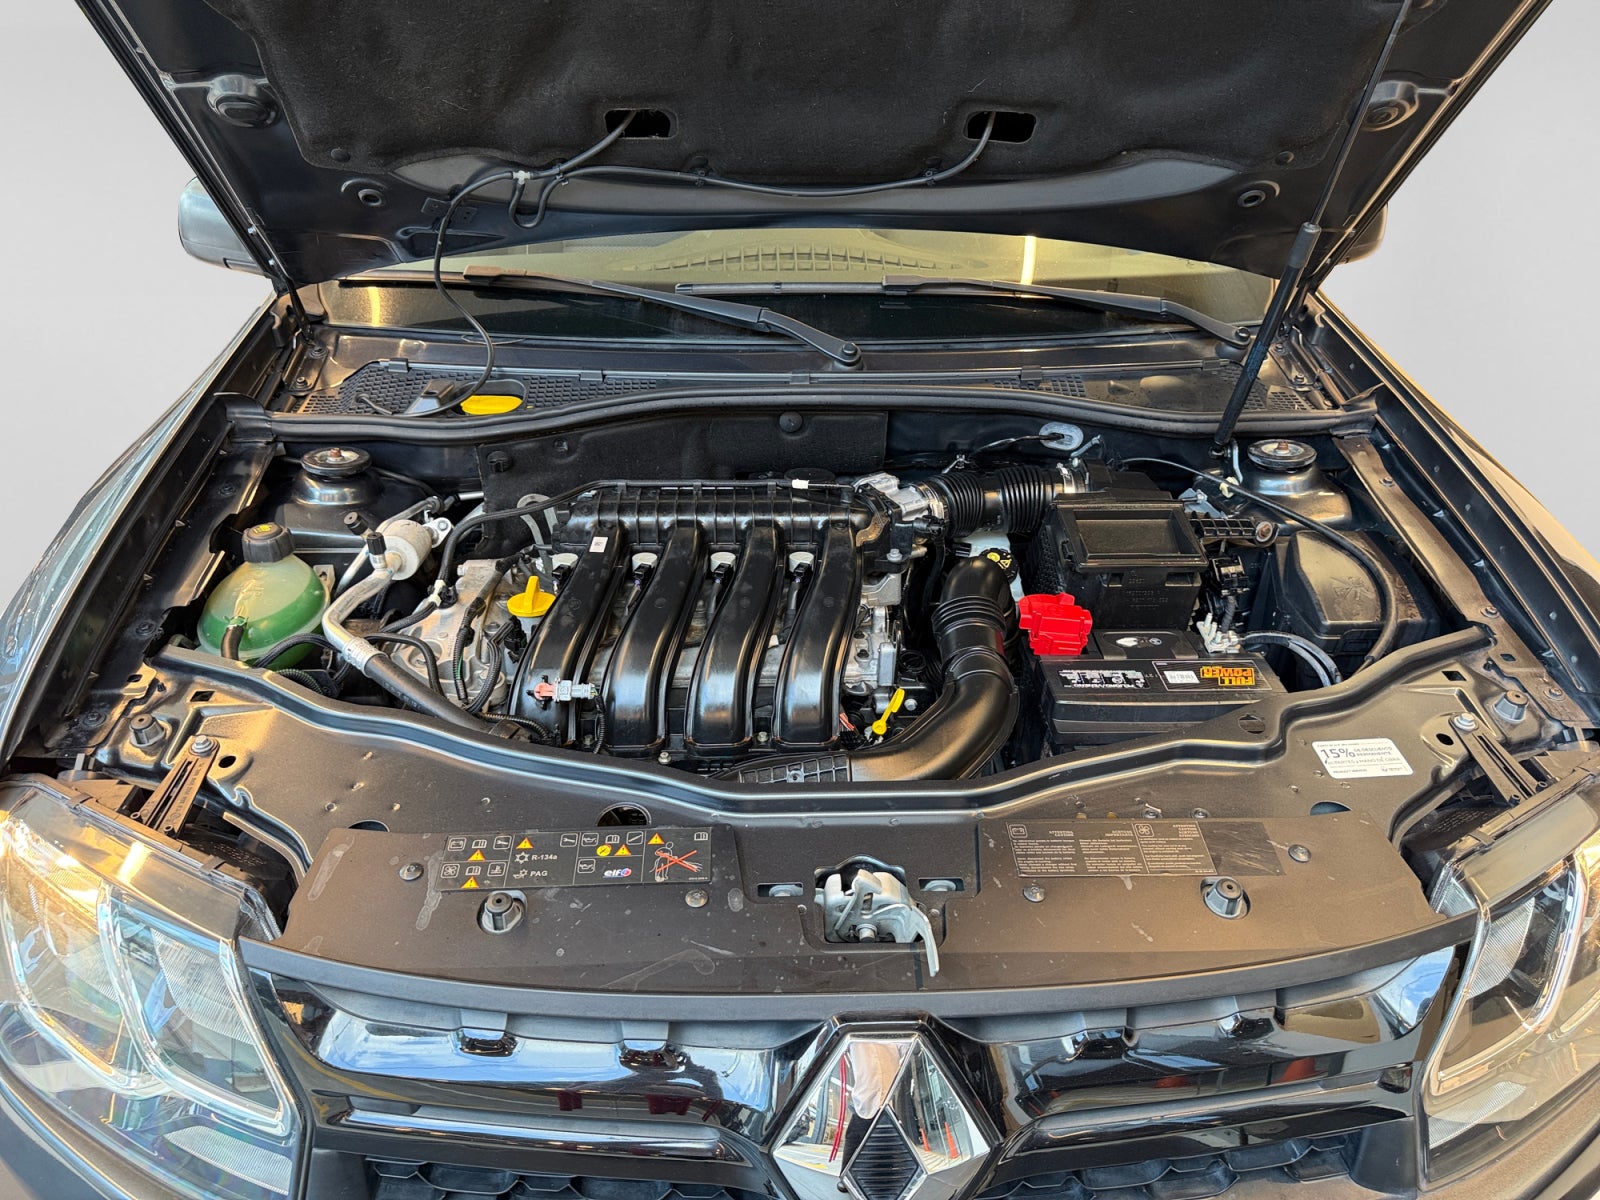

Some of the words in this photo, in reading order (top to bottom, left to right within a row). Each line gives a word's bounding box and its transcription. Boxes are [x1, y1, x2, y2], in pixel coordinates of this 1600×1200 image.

[1202, 667, 1252, 677] POWER
[1222, 676, 1253, 685] FULL
[1320, 748, 1356, 759] 15%
